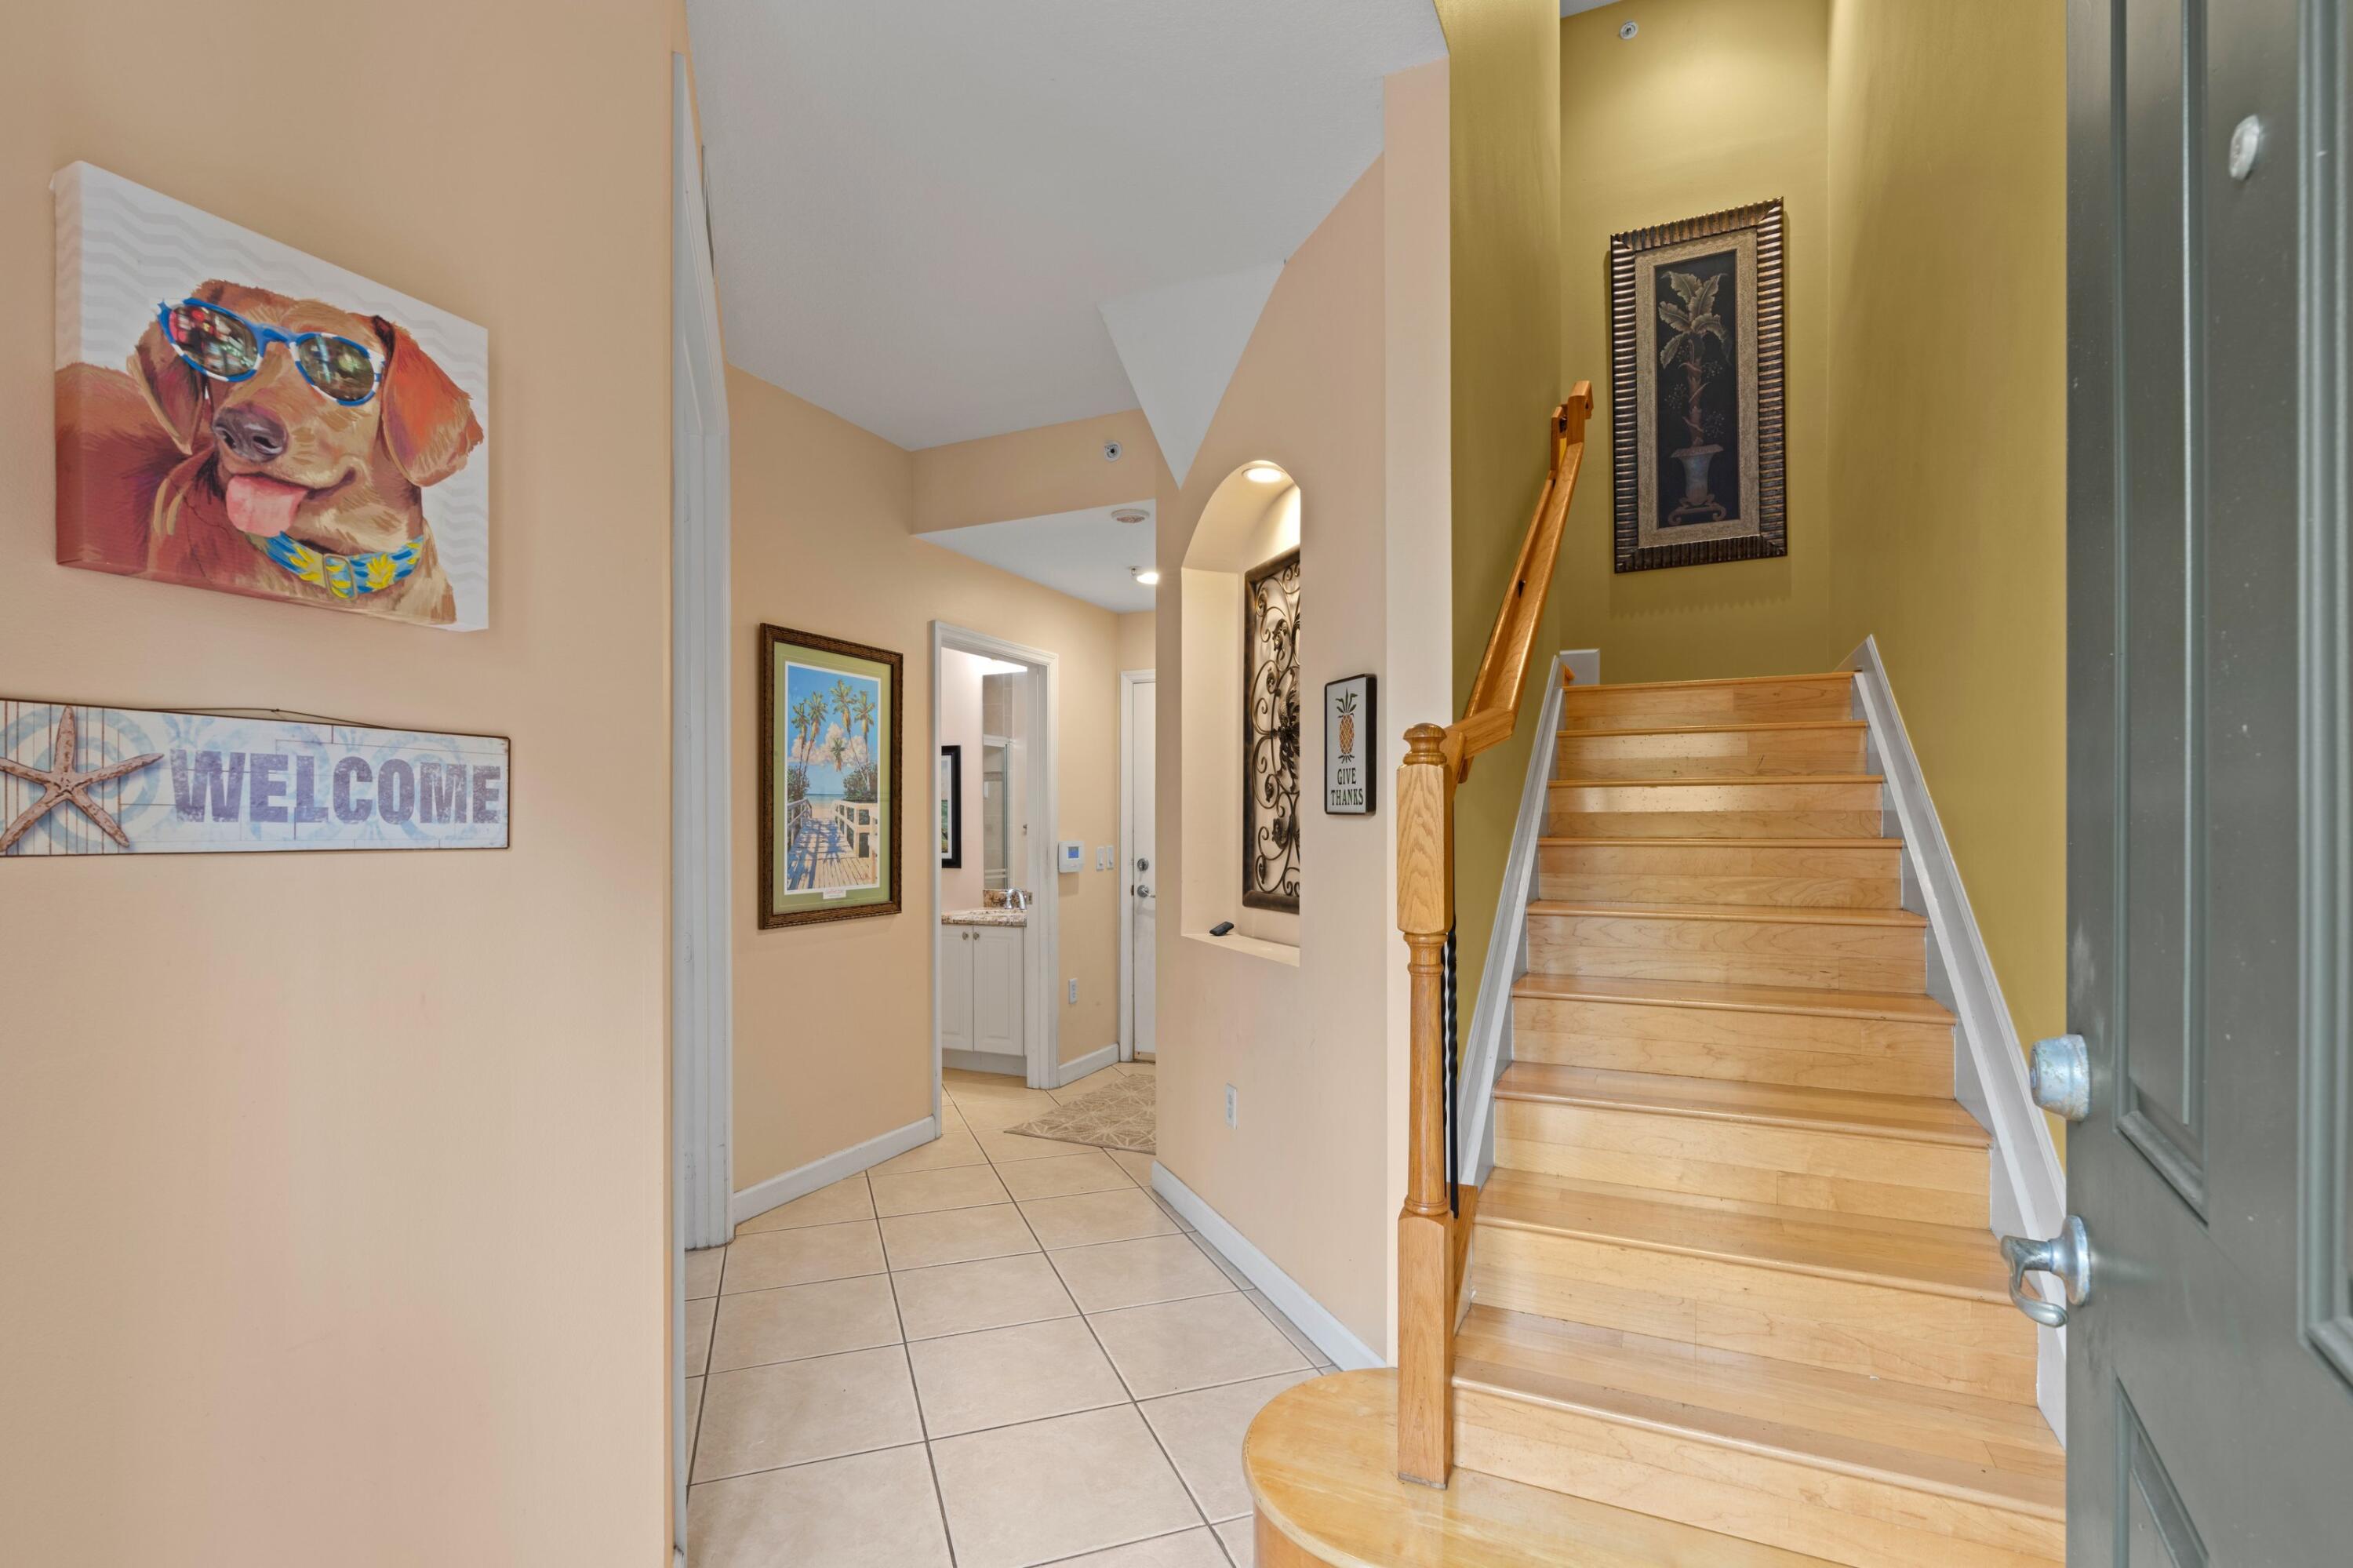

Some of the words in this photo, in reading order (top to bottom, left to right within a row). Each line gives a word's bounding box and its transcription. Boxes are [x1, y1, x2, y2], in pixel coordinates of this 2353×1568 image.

[1337, 768, 1356, 785] GIVE
[169, 749, 501, 824] WELCOME
[1331, 788, 1363, 806] THANKS
